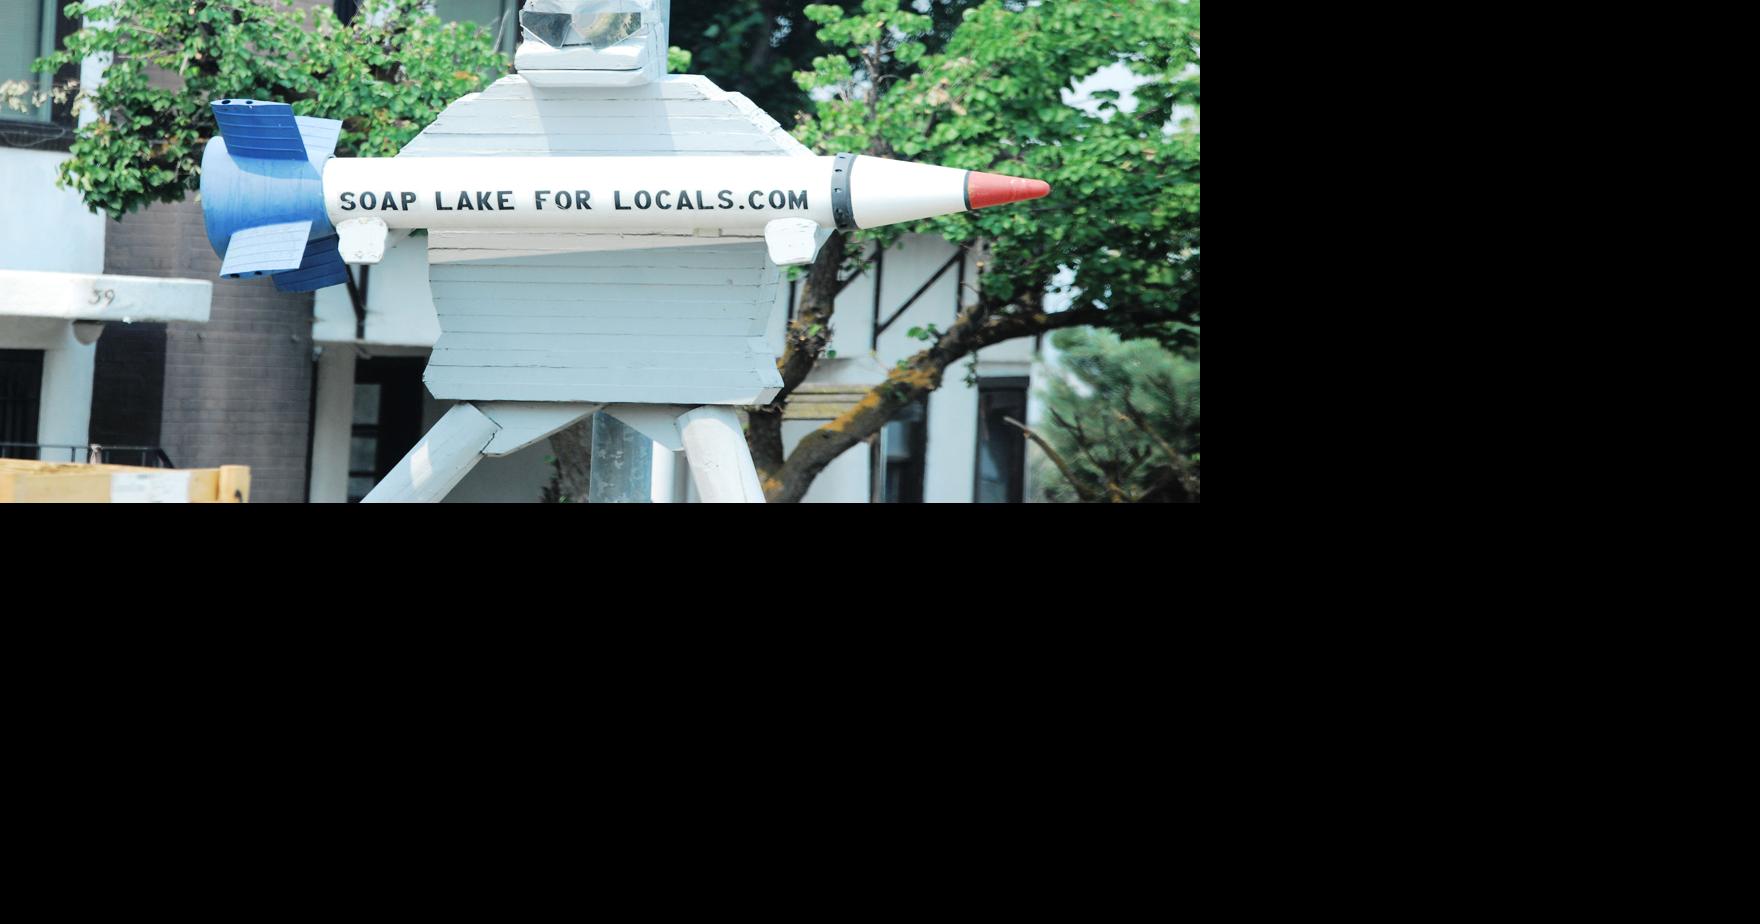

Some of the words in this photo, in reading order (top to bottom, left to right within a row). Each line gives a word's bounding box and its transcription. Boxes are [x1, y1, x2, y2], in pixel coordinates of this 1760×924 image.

[339, 190, 418, 212] SOAP
[435, 190, 515, 211] LAKE
[535, 190, 593, 211] FOR
[614, 189, 809, 211] LOCALS.COM
